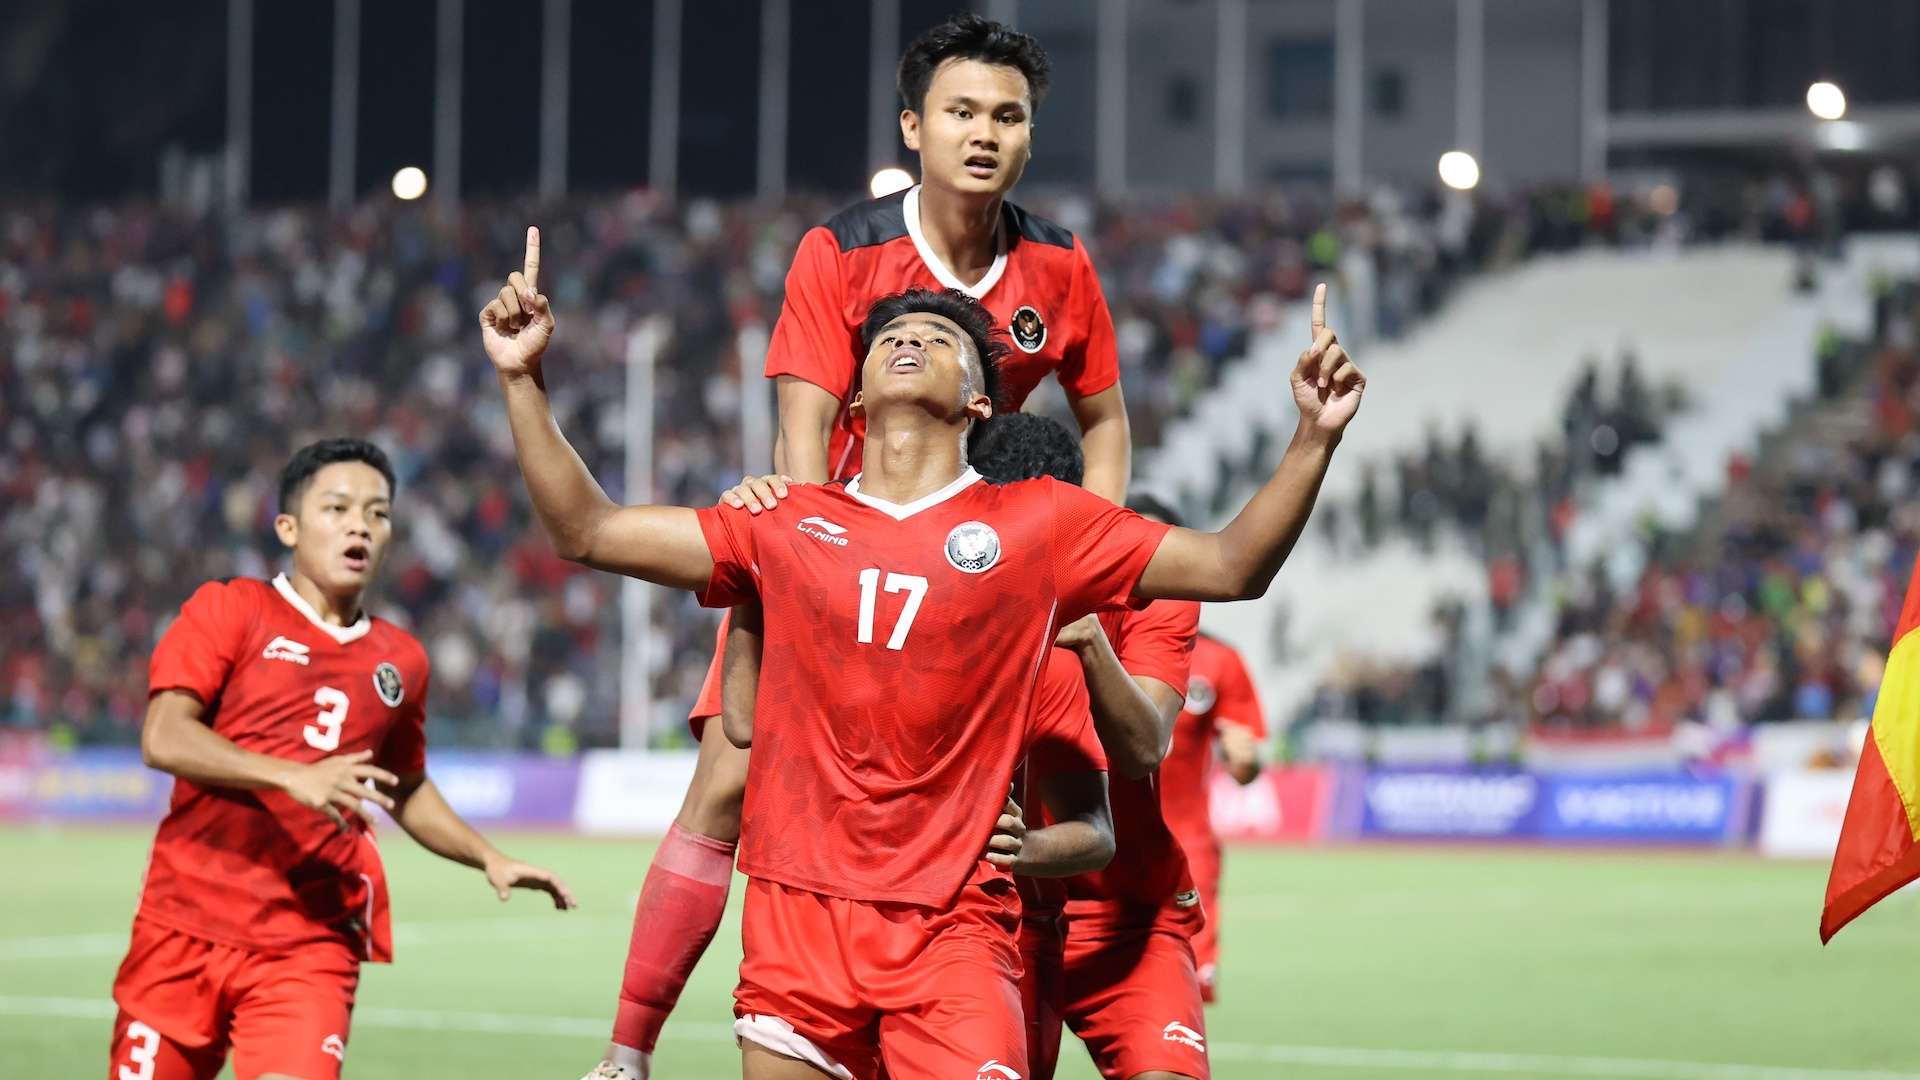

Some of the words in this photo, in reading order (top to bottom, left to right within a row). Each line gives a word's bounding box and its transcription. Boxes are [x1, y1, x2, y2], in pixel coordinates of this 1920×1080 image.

[796, 522, 849, 546] LI-NING
[857, 567, 929, 651] 17
[303, 686, 350, 752] 3
[118, 1020, 161, 1080] 3
